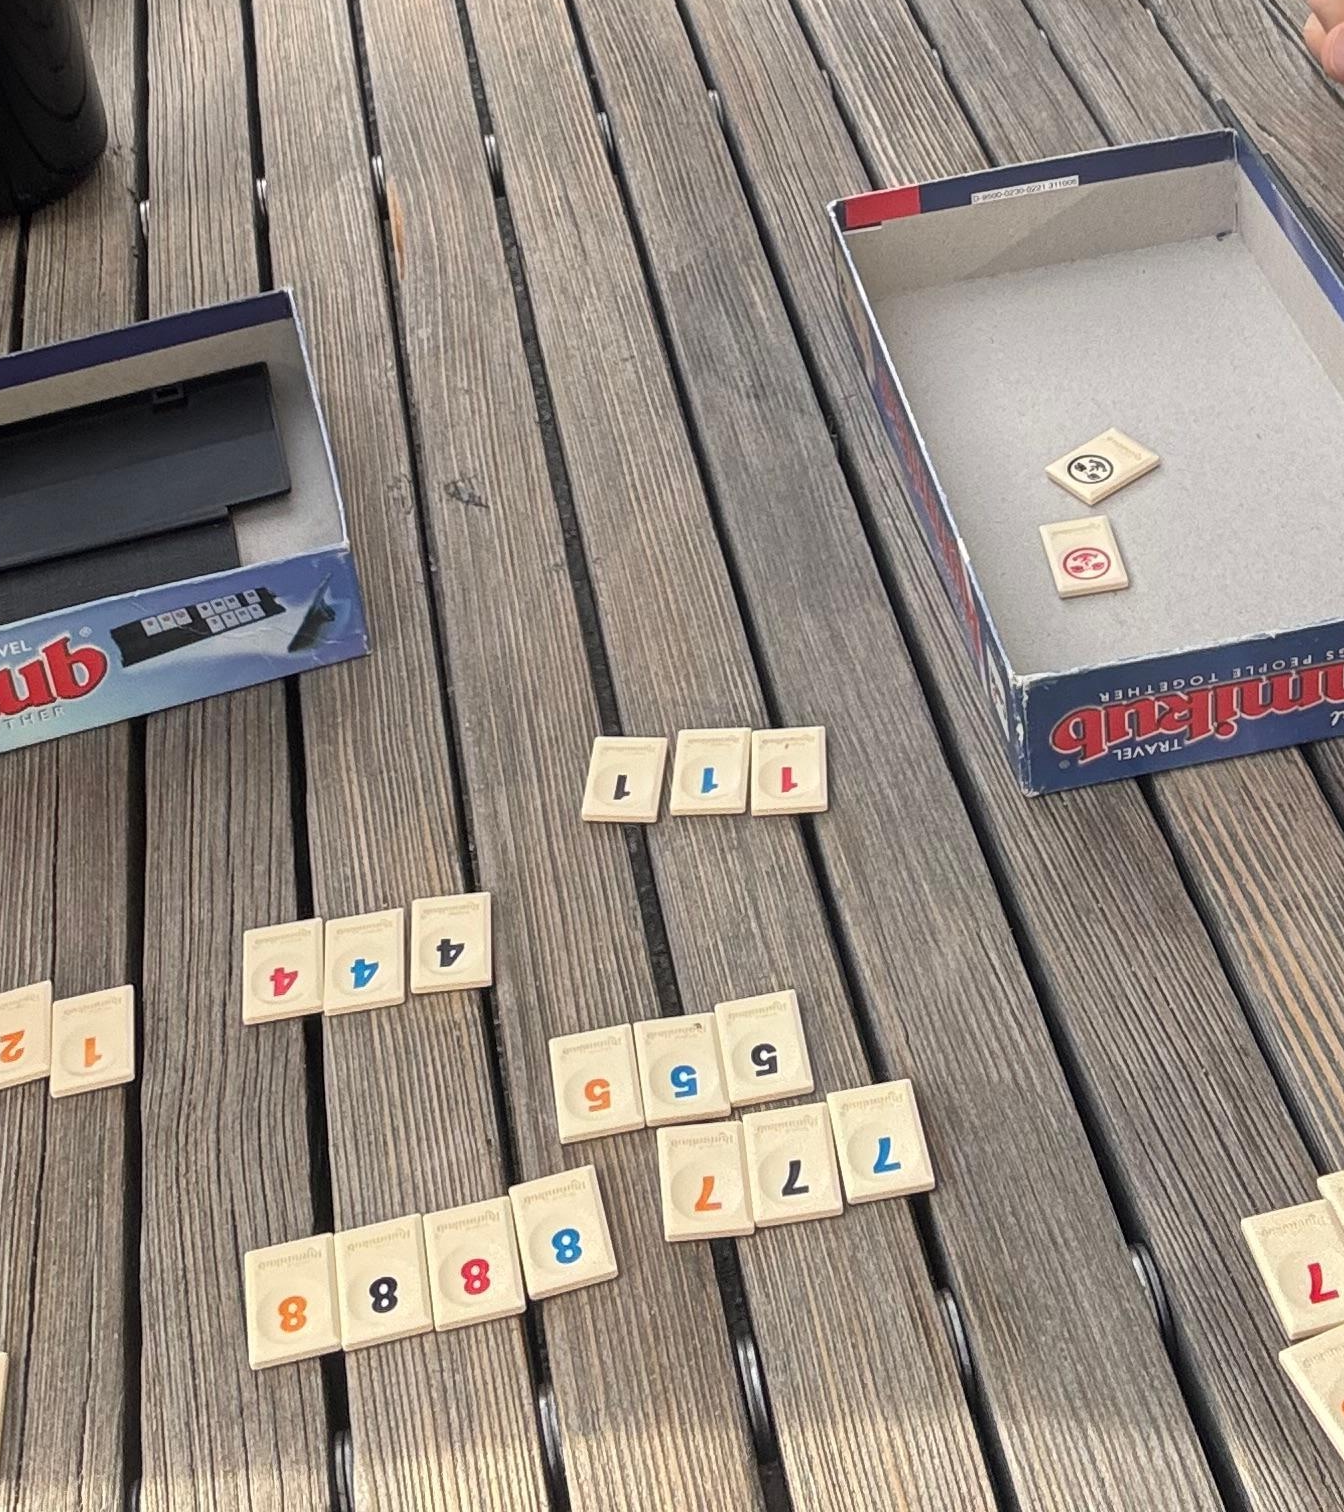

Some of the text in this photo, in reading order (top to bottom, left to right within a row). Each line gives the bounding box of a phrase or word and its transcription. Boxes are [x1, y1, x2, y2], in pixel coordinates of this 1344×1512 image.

[1232, 654, 1313, 679] PEOPLE
[1099, 673, 1216, 703] TOGETHER
[1112, 739, 1183, 762] TRAVEL
[613, 774, 630, 800] 1
[702, 767, 716, 793] 1
[781, 766, 797, 793] 1
[436, 938, 465, 968] 4
[270, 967, 299, 997] 4
[351, 959, 378, 988] 4
[0, 1030, 24, 1063] 2
[84, 1037, 102, 1066] 1
[750, 1043, 778, 1077] 5
[584, 1079, 611, 1112] 5
[670, 1065, 698, 1097] 5
[873, 1137, 900, 1174] 7
[694, 1176, 720, 1212] 7
[781, 1160, 809, 1197] 7
[551, 1228, 582, 1264] 8
[460, 1258, 491, 1296] 8
[1307, 1262, 1339, 1304] 7
[369, 1276, 398, 1314] 8
[277, 1295, 307, 1333] 8
